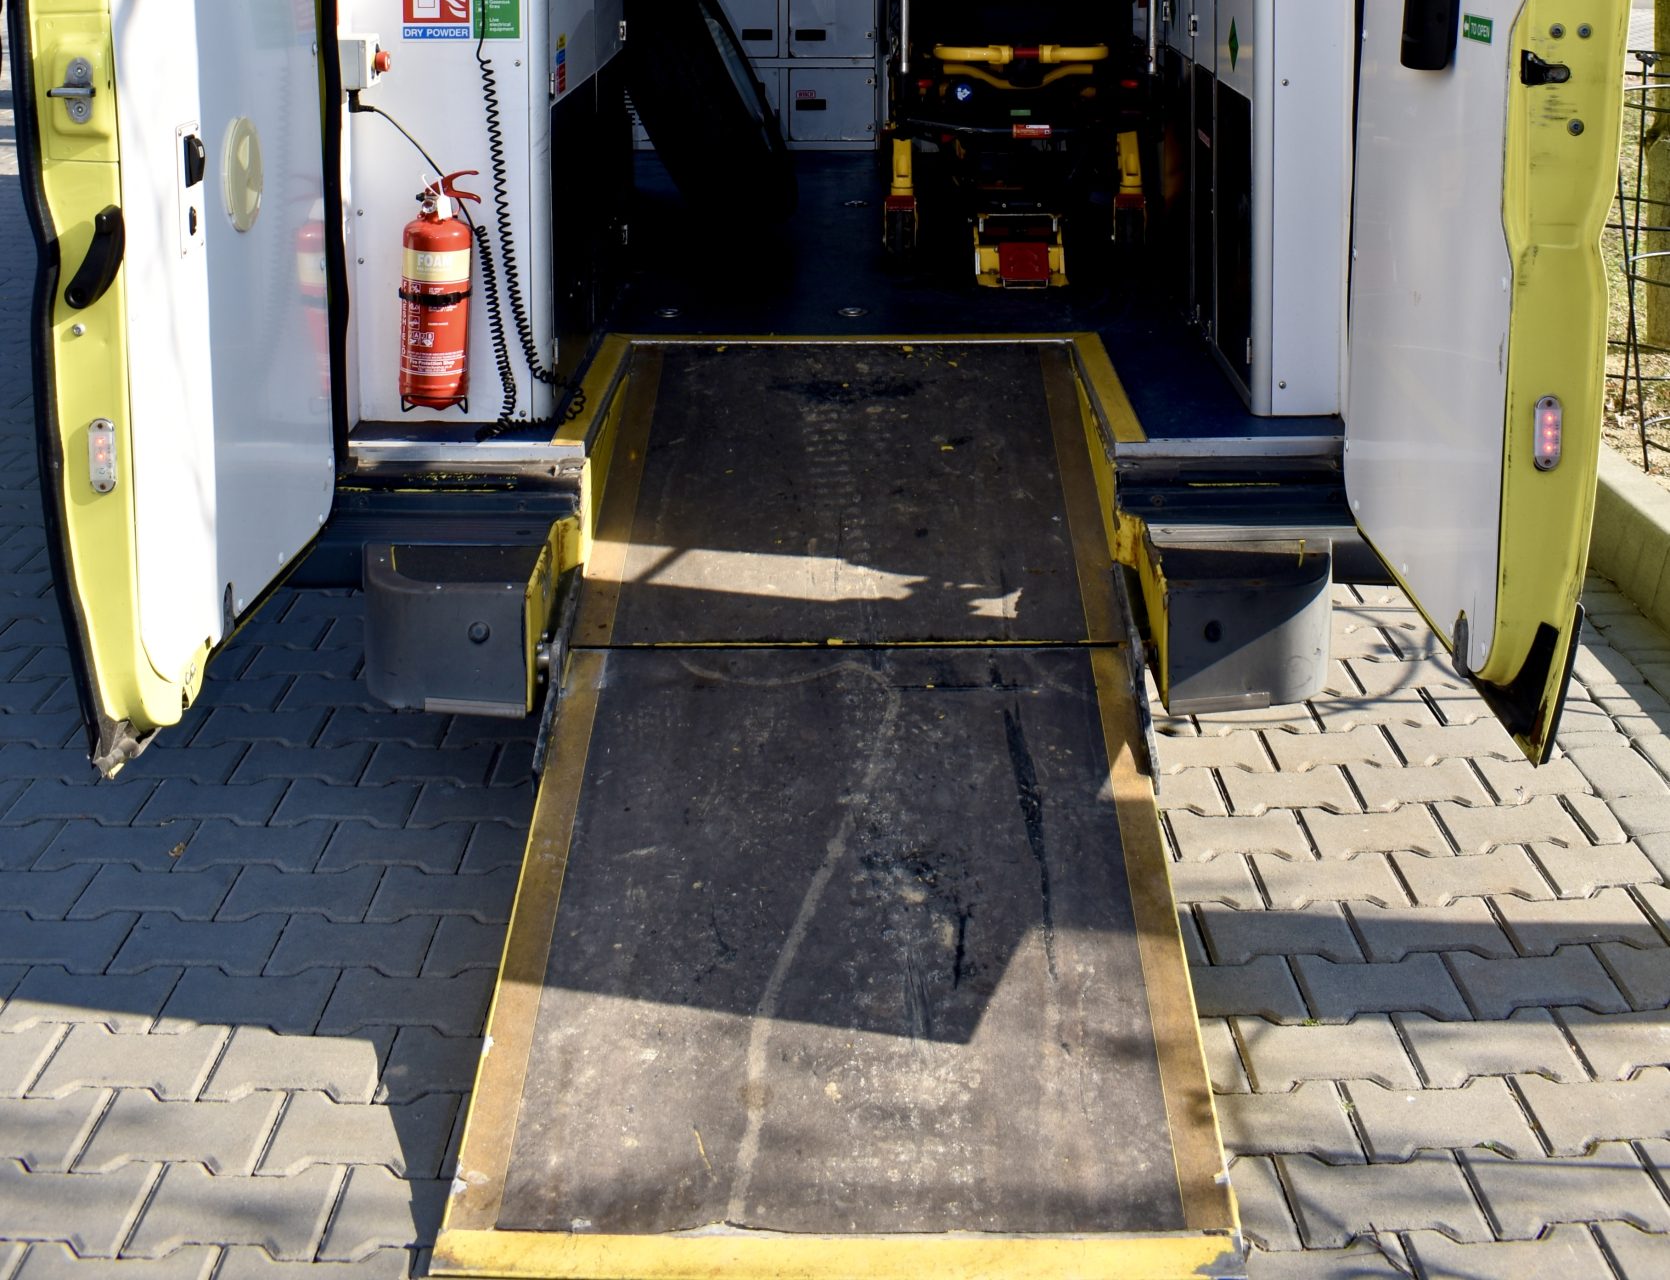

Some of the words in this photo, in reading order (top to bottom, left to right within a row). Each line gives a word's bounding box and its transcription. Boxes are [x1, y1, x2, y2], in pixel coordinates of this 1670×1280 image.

[404, 28, 423, 37] DRY
[426, 28, 469, 37] POWDER
[1471, 22, 1477, 36] TO
[1477, 24, 1490, 39] OPEN
[417, 254, 453, 267] FOAM
